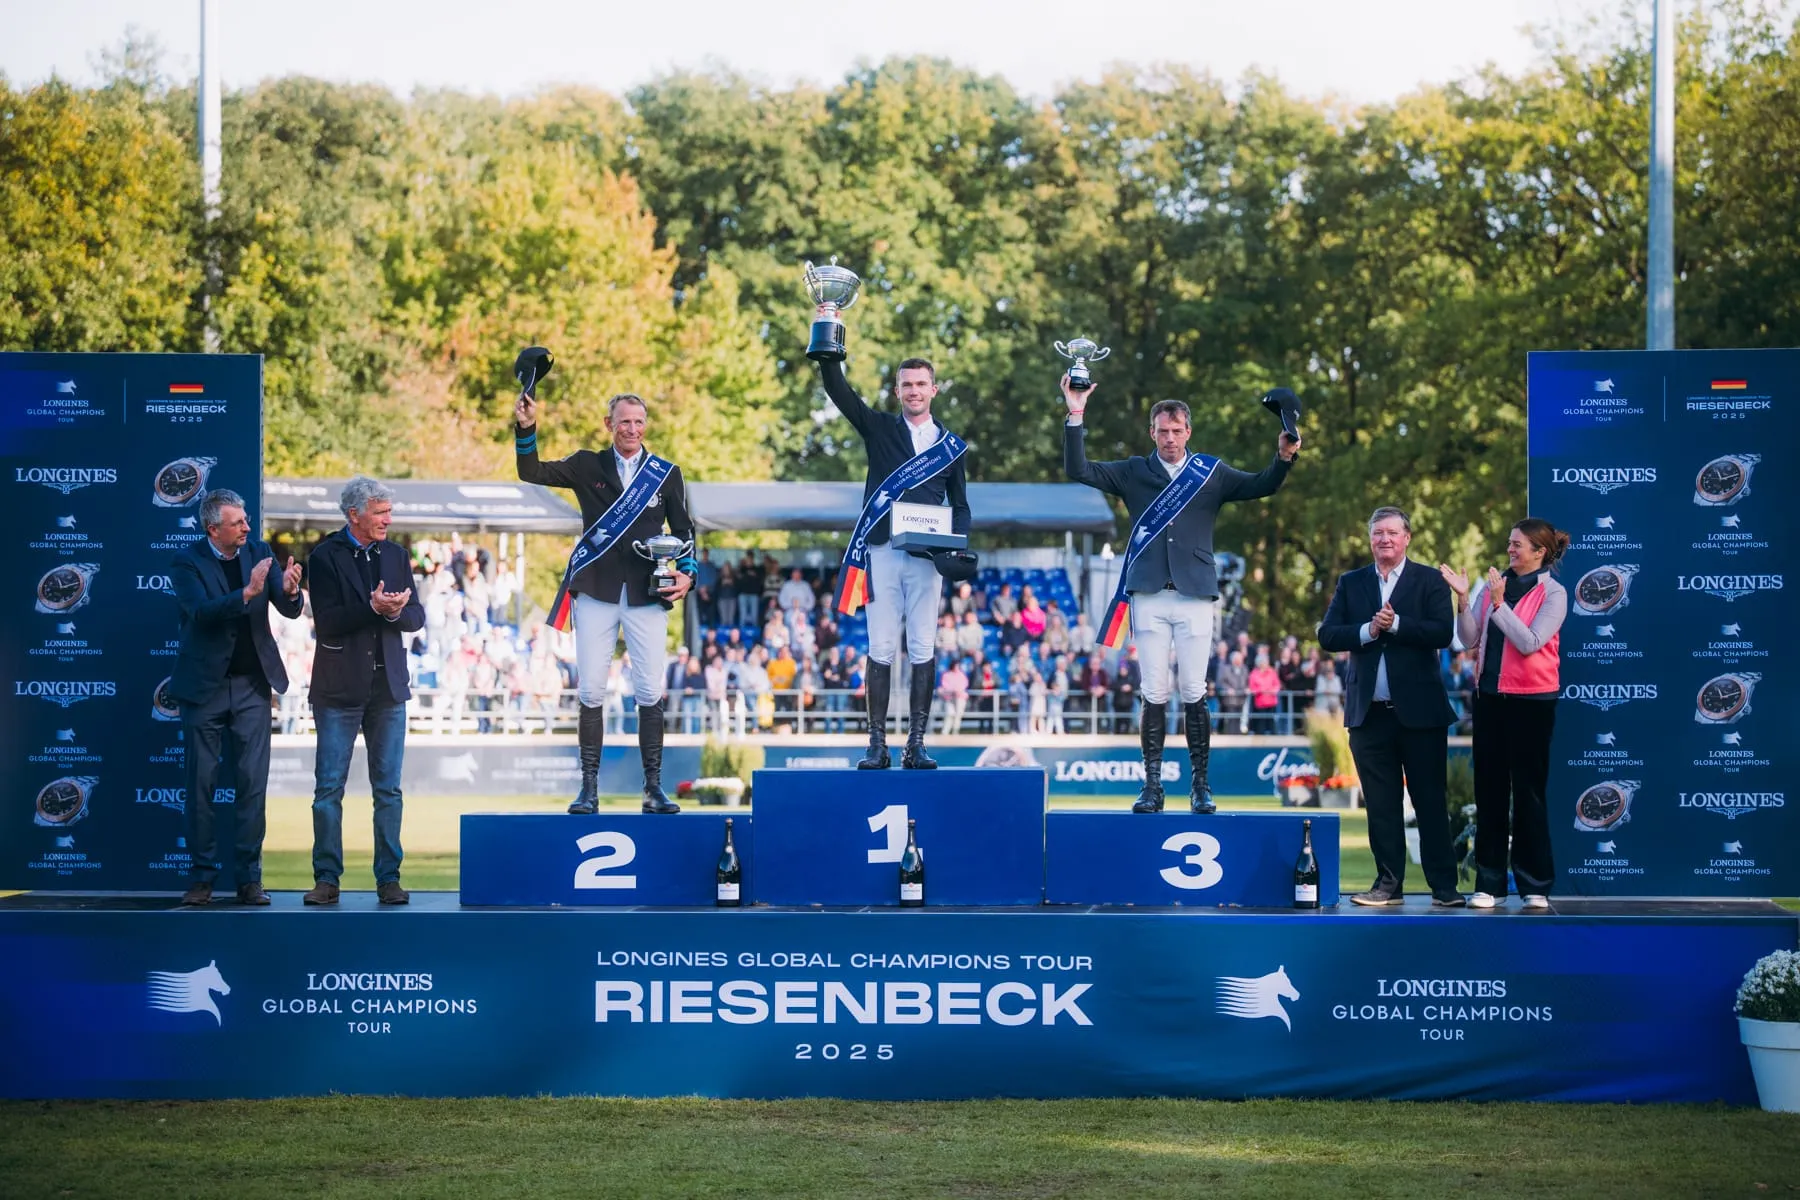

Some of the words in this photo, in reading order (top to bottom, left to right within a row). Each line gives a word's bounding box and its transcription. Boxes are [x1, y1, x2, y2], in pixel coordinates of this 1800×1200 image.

[146, 405, 226, 413] RIESENBECK
[1687, 401, 1770, 410] RIESENBECK
[898, 456, 928, 478] LONGINES
[912, 455, 941, 475] CHAMPIONS
[16, 468, 117, 484] LONGINES
[1552, 468, 1656, 484] LONGINES
[1152, 507, 1168, 524] GLOBAL
[1168, 479, 1193, 506] CHAMPIONS
[1155, 484, 1180, 512] LONGINES
[903, 516, 939, 524] LONGINES
[1678, 575, 1783, 591] LONGINES
[16, 681, 116, 697] LONGINES
[136, 788, 235, 802] LONGES
[1680, 793, 1784, 809] LONGINES
[868, 805, 923, 863] 1
[574, 832, 636, 889] 2
[1160, 832, 1223, 889] 3
[598, 951, 728, 966] LONGINES
[738, 953, 840, 967] GLOBAL
[851, 954, 1010, 969] CHAMPIONS
[1020, 956, 1092, 970] TOUR
[308, 973, 432, 991] LONGINES
[1378, 980, 1506, 997] LONGINES
[263, 999, 342, 1013] GLOBAL
[352, 999, 476, 1013] CHAMPIONS
[595, 980, 1093, 1025] RIESENBECK
[1333, 1005, 1414, 1019] GLOBAL
[1424, 1006, 1552, 1021] CHAMPIONS
[348, 1022, 391, 1033] TOUR
[1420, 1029, 1464, 1040] TOUR
[796, 1044, 893, 1060] 2025
